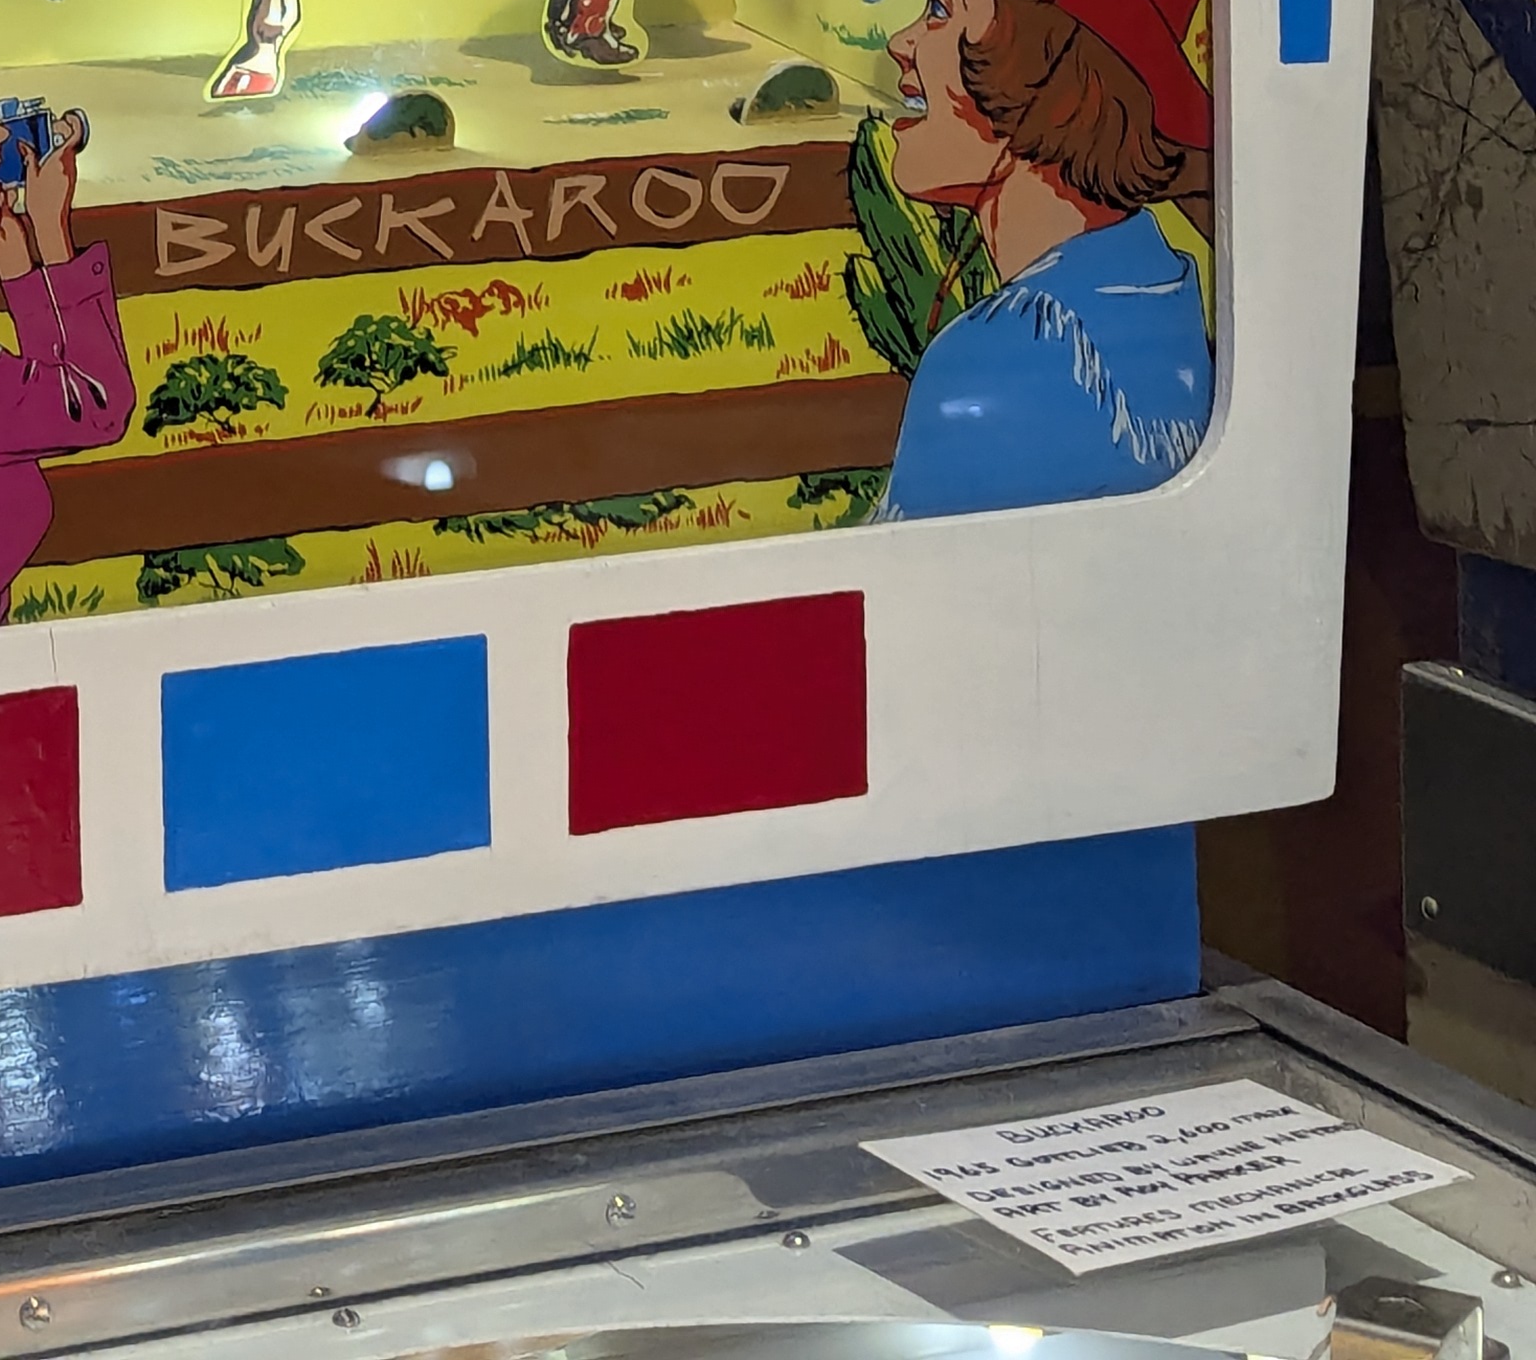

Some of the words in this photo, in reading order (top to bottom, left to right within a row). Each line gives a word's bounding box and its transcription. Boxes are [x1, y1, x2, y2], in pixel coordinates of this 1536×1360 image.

[154, 161, 790, 277] BUCKAROO
[995, 1105, 1166, 1144] BUCKAROO
[922, 1161, 1001, 1182] 1965
[965, 1171, 1125, 1203] DESIGNED
[992, 1200, 1063, 1219] ART
